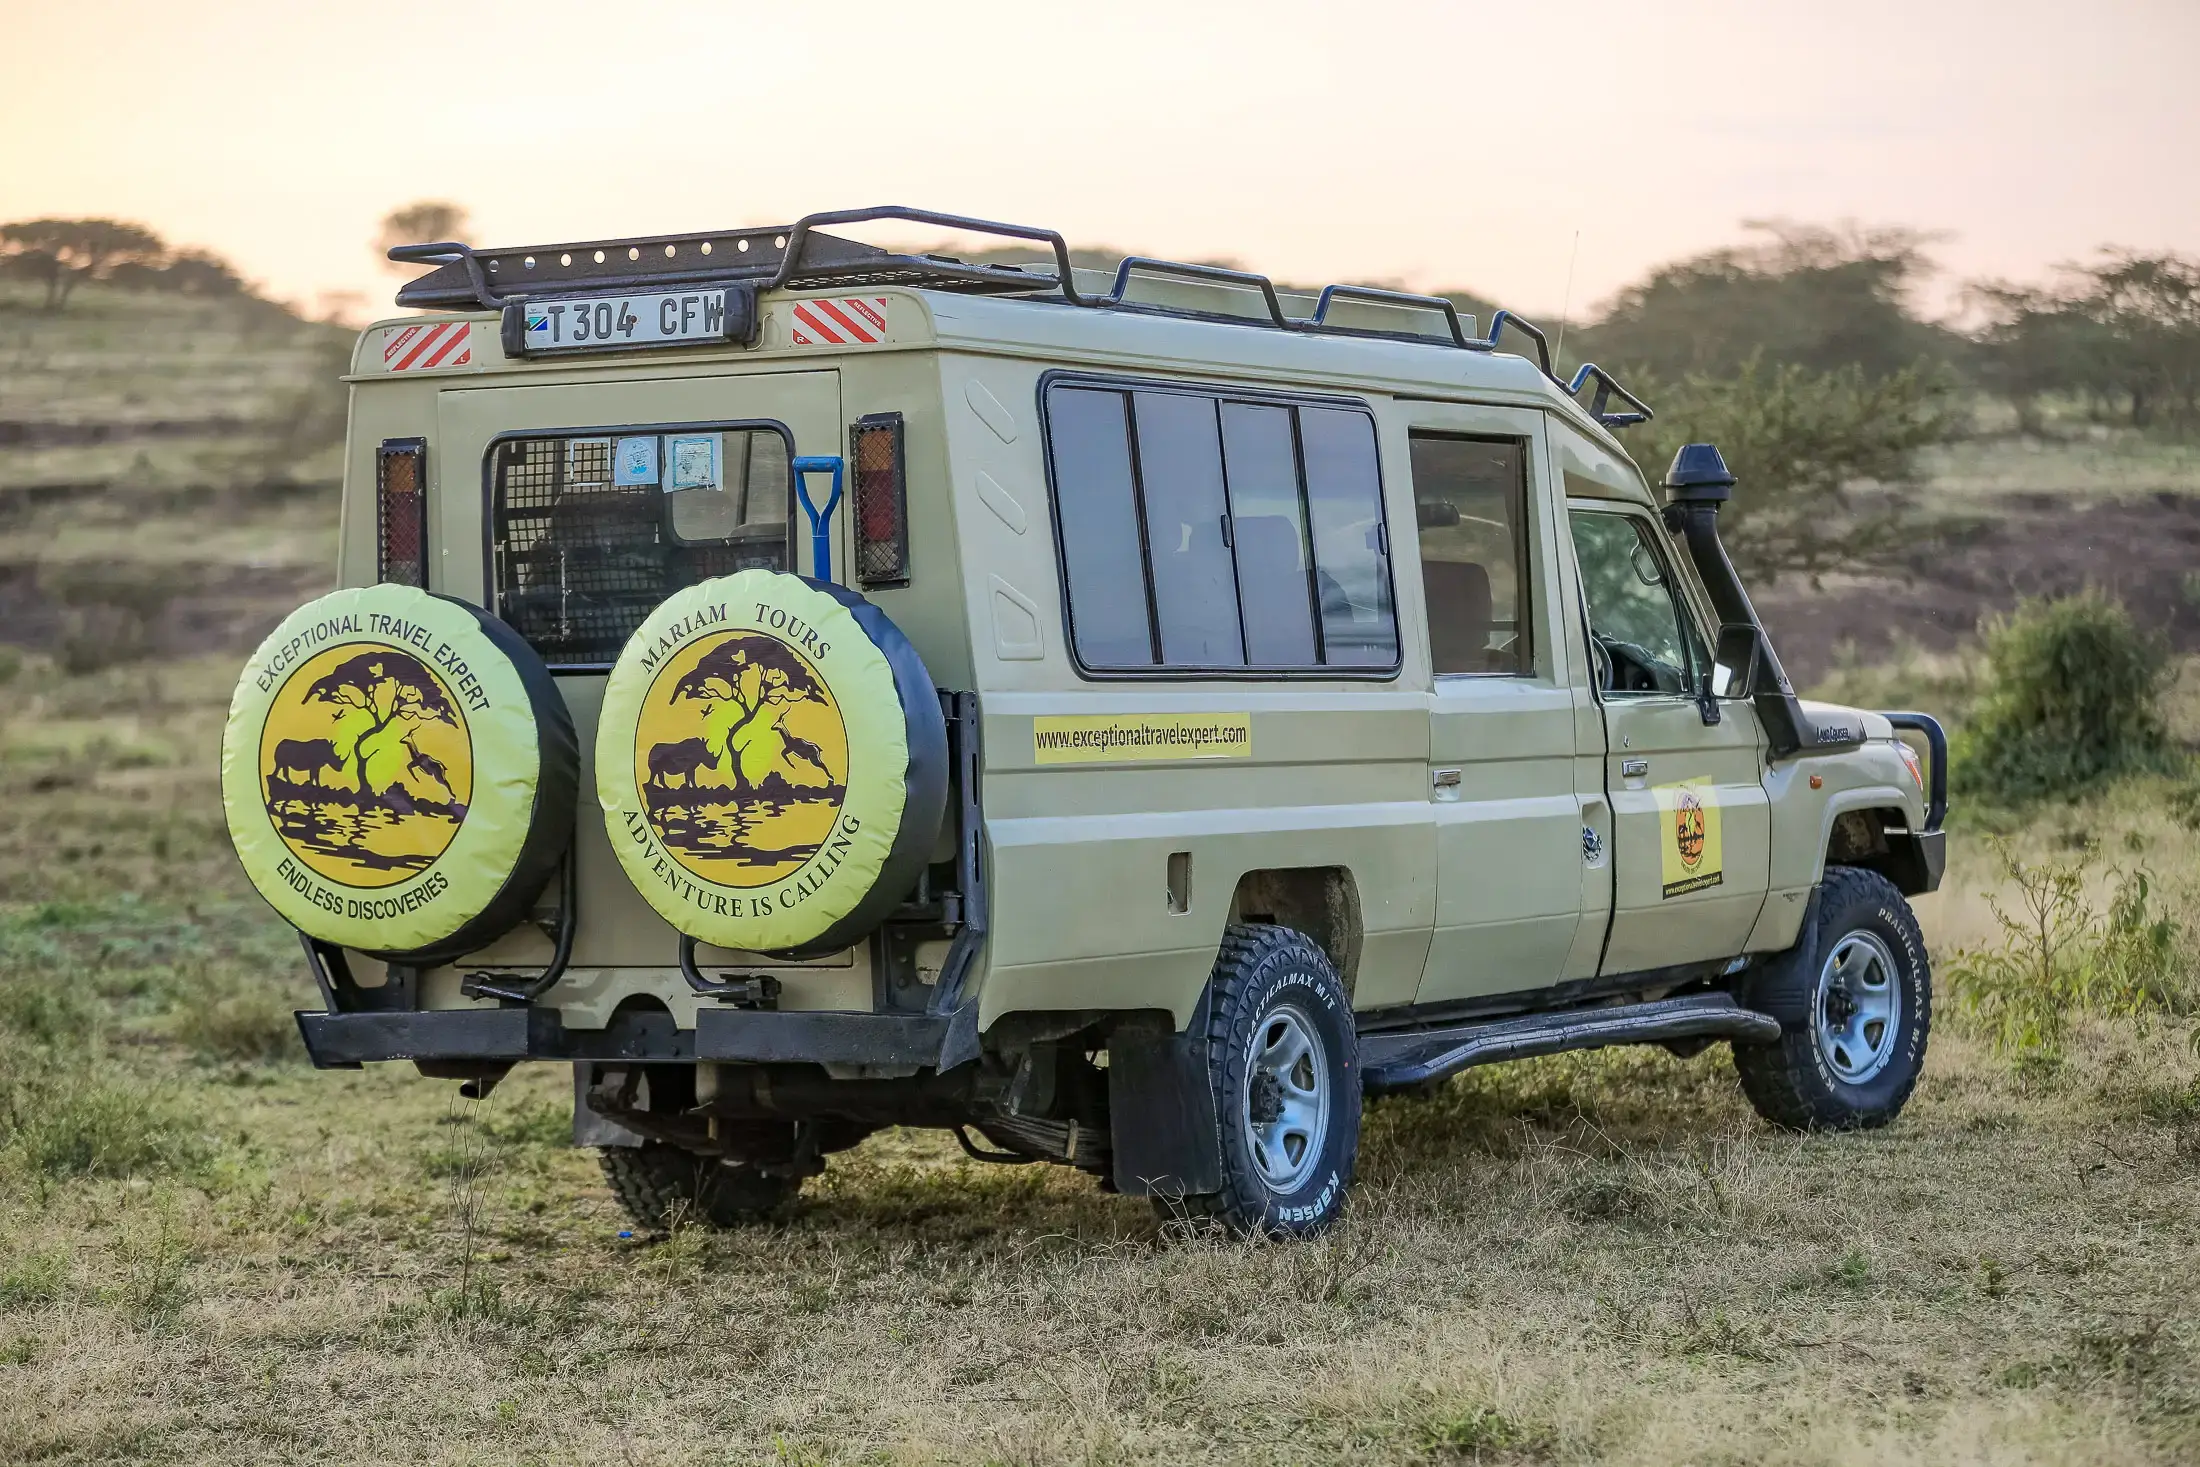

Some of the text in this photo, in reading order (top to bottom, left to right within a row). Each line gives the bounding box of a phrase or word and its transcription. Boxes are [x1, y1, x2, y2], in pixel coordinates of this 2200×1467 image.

[547, 294, 722, 342] T 304 CFW
[853, 301, 882, 327] REFLECTIVE
[387, 328, 416, 357] REFLECTIVE
[256, 613, 491, 713] EXCEPTIONAL TRAVEL EXPERT
[639, 602, 832, 675] MARIAM TOURS
[1036, 720, 1247, 752] www.exceptionaltravelexpert.com
[276, 857, 450, 920] ENDLESS DISCOVERIES
[622, 808, 861, 918] ADVENTURE IS CALLING
[1315, 982, 1335, 1010] M/T
[1878, 907, 1922, 1062] PRACTICALMAX M/T
